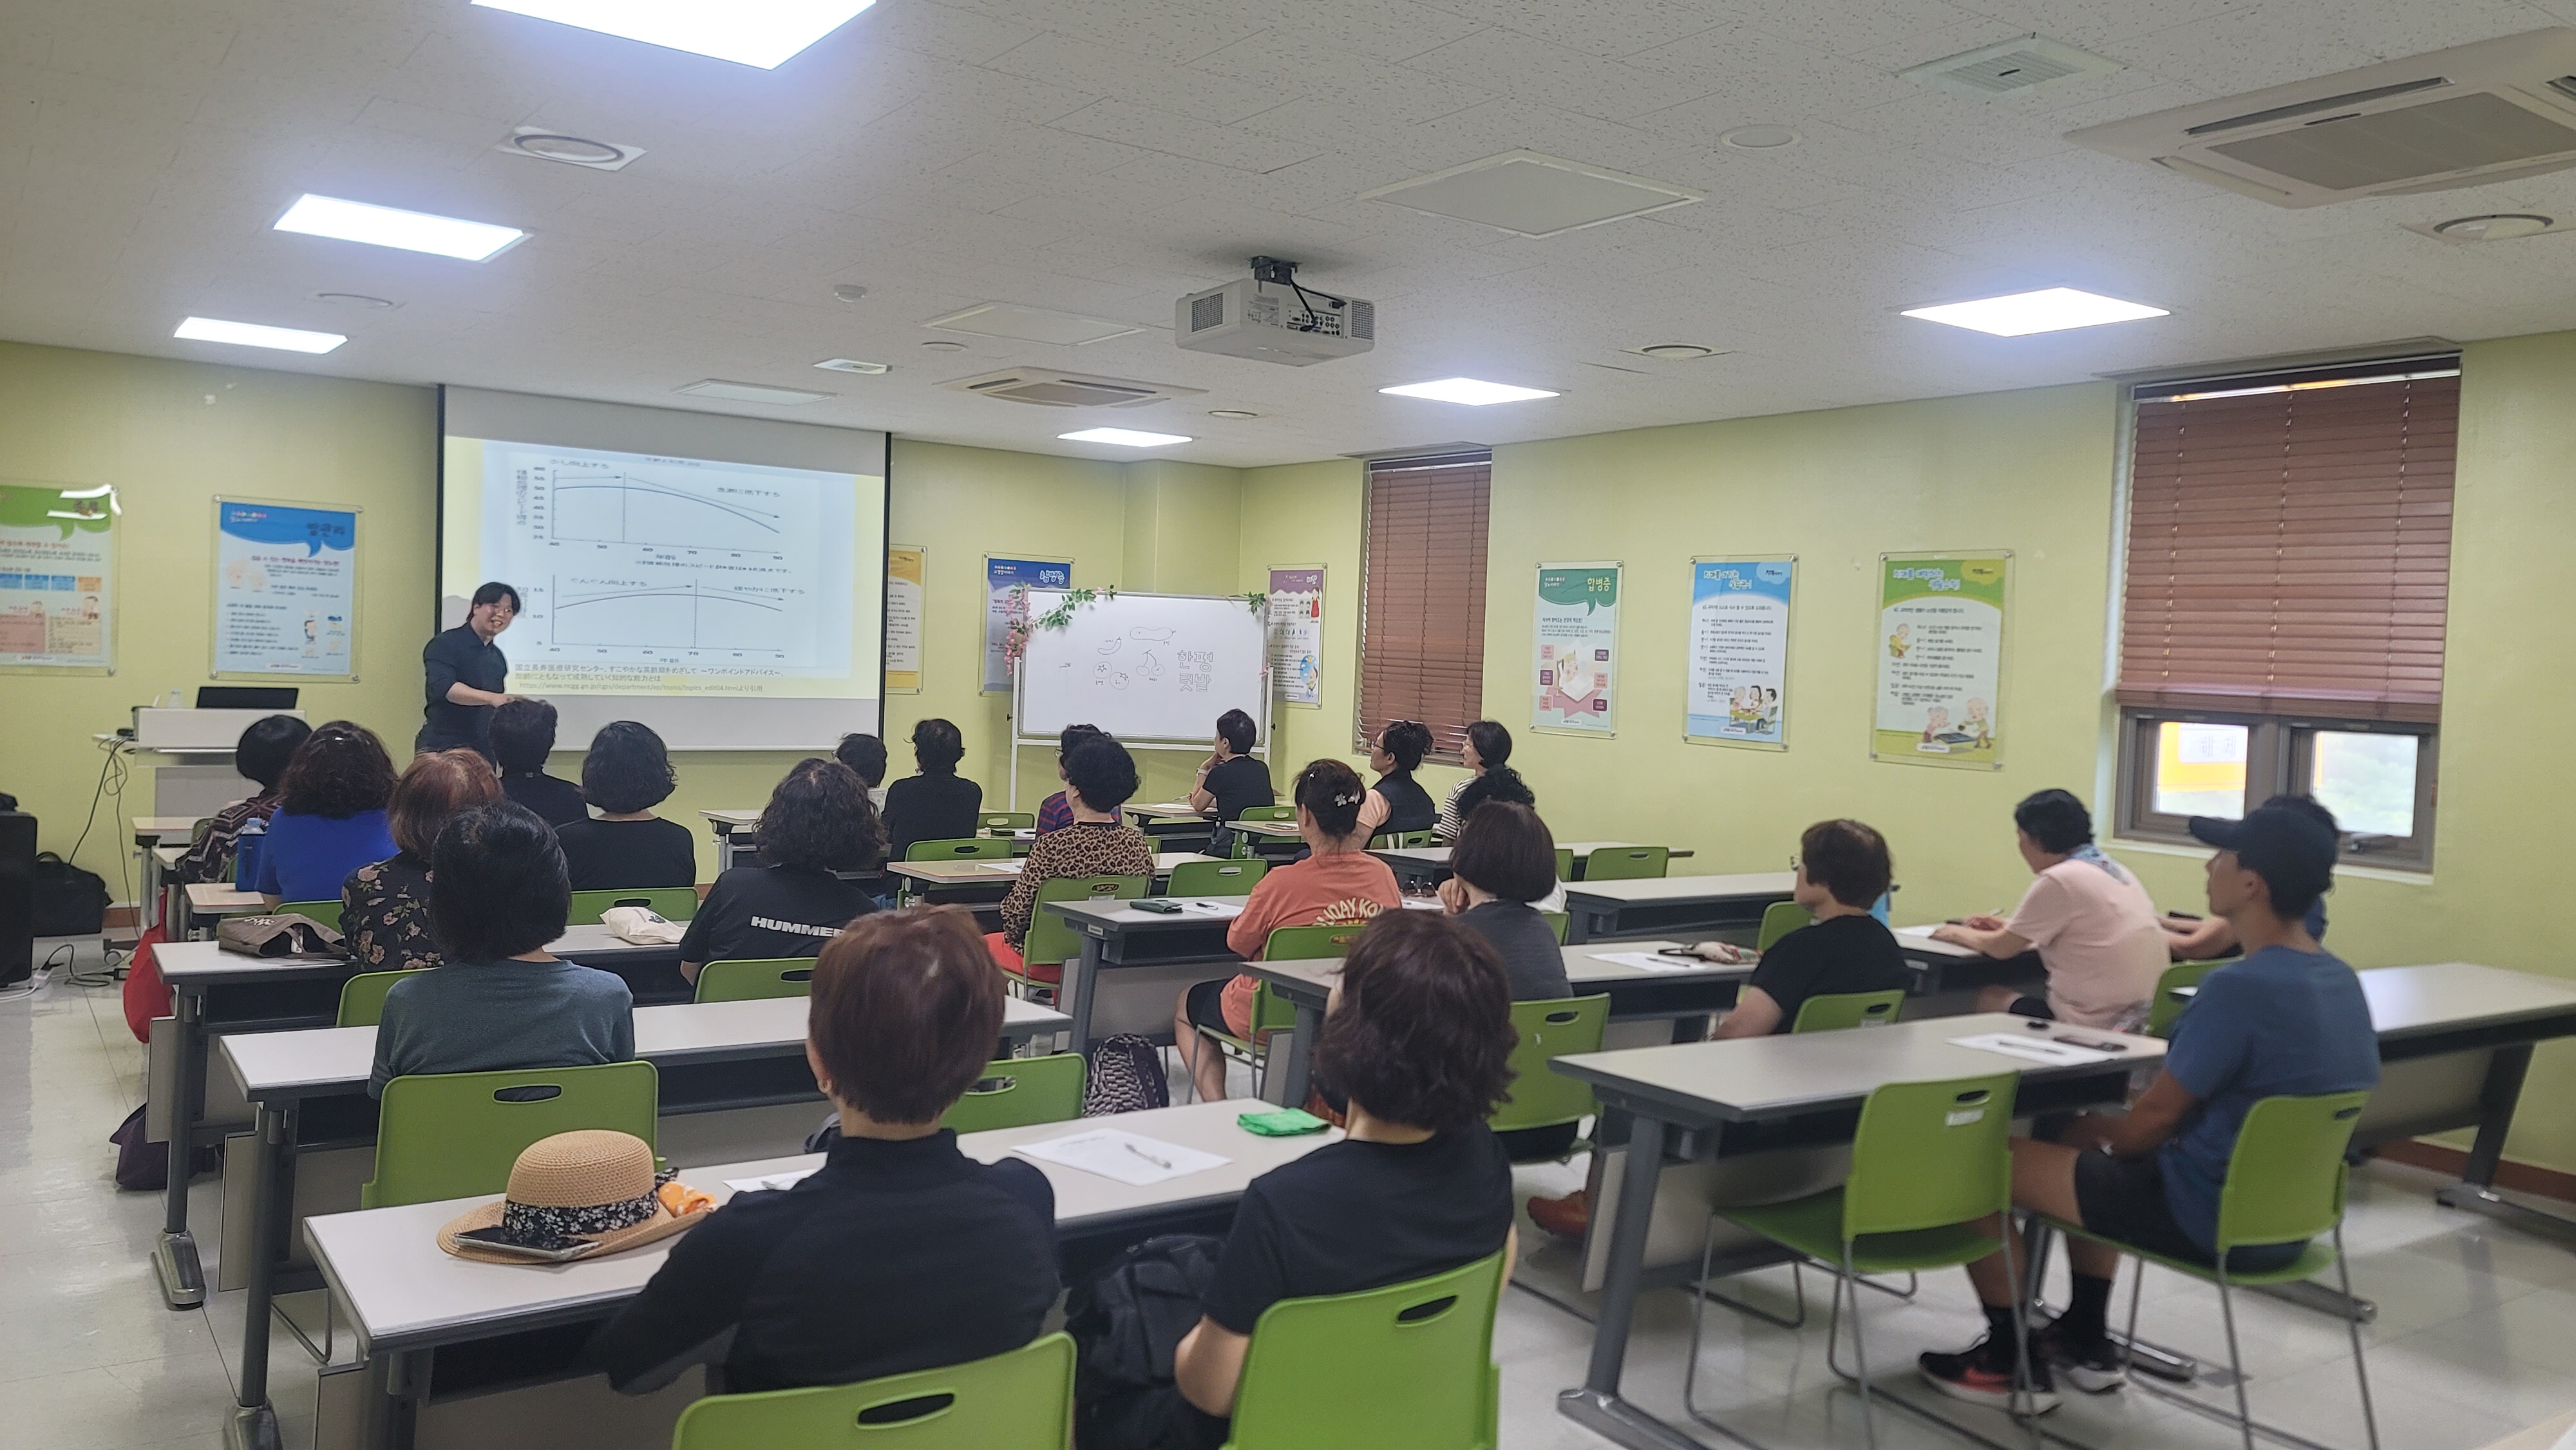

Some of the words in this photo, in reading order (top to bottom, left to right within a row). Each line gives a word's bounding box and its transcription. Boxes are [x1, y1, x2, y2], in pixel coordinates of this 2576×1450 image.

[1039, 570, 1065, 585] 합병증
[1587, 577, 1611, 592] 합병증
[1177, 650, 1214, 673] 한평
[1179, 673, 1213, 693] 텃밭
[1311, 898, 1356, 926] LIDAY
